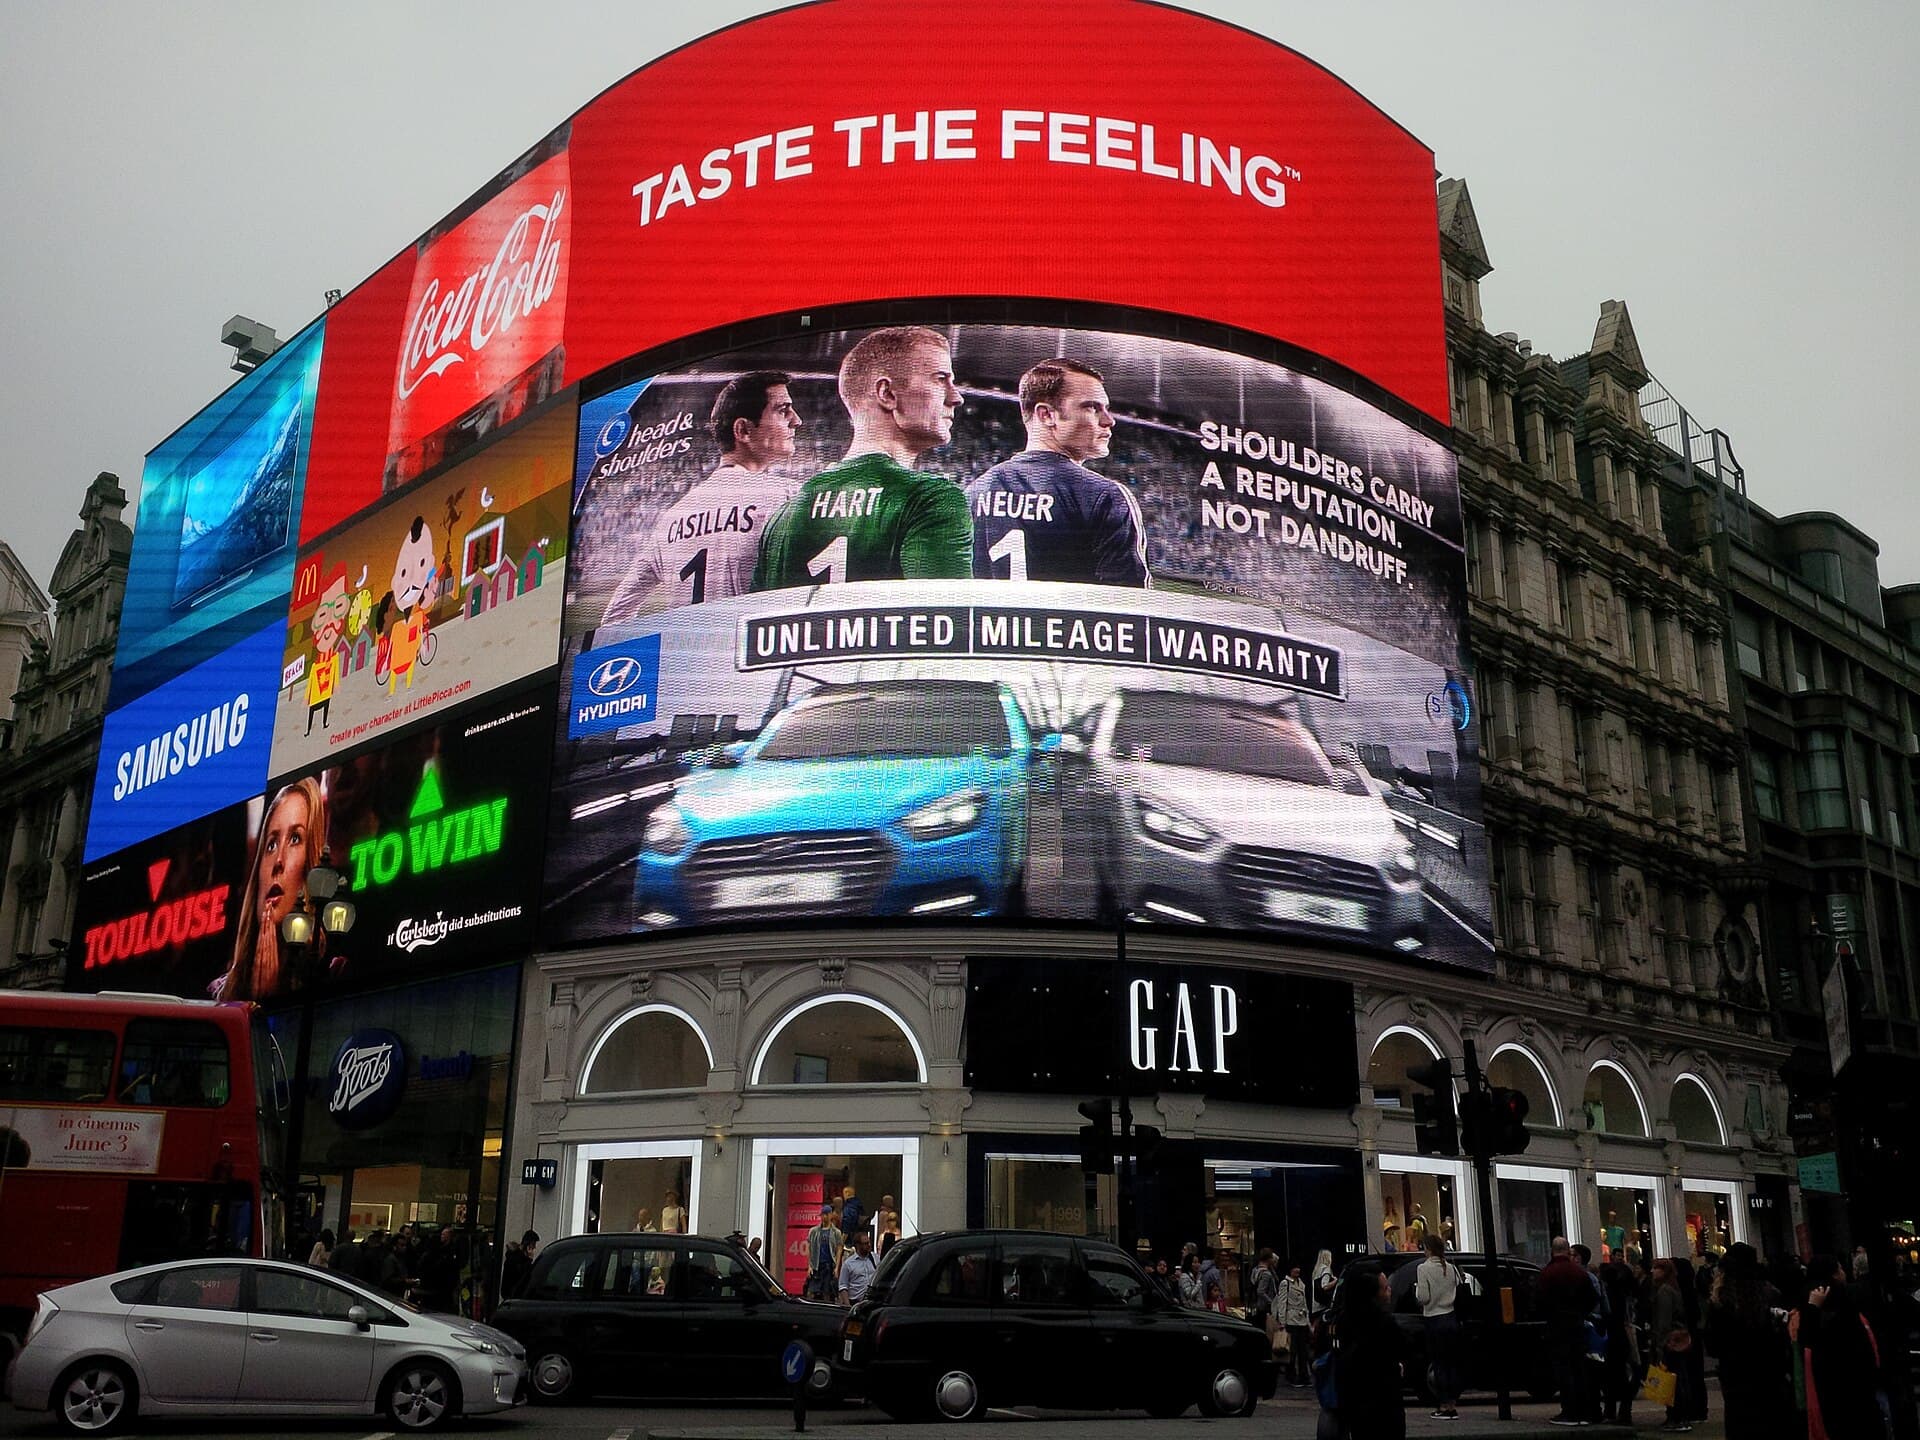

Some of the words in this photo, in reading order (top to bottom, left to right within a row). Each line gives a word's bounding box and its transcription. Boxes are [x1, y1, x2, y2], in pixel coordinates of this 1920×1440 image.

[632, 125, 814, 227] TASTE
[833, 108, 976, 167] THE
[1001, 109, 1286, 207] FEELING
[398, 184, 567, 400] Coca-Cola
[599, 436, 693, 479] shoulders
[1199, 421, 1364, 495] SHOULDERS
[1369, 476, 1434, 528] CARRY
[667, 504, 757, 543] CASILLAS
[811, 487, 884, 520] HART
[976, 491, 1054, 522] NEUER
[1200, 461, 1225, 490] A
[1236, 466, 1402, 548] REPUTATION.
[807, 537, 848, 583] 1
[988, 529, 1027, 581] 1
[1201, 499, 1270, 538] NOT
[1281, 515, 1414, 589] DANDRUFF.
[679, 548, 708, 604] 1
[284, 661, 303, 683] BEACH
[756, 615, 954, 657] UNLIMITED
[981, 615, 1135, 654] MILEAGE
[1158, 627, 1331, 684] WARRANTY
[329, 726, 352, 745] Create
[353, 722, 369, 739] your
[369, 708, 403, 730] character
[403, 703, 412, 716] at
[413, 680, 471, 711] LittlePicca.com
[464, 711, 515, 737] drinkaware.co.uk
[578, 694, 647, 724] HYUNDAI
[113, 693, 249, 801] SAMSUNG
[350, 832, 403, 892] TO
[409, 797, 508, 874] WIN
[83, 885, 231, 969] TOULOUSE
[387, 932, 395, 946] If
[396, 914, 449, 952] Carlsberg
[448, 916, 464, 931] did
[464, 906, 522, 928] substitutions
[1129, 979, 1238, 1074] GAP
[329, 1042, 393, 1112] Boots
[58, 1114, 73, 1129] in
[77, 1115, 140, 1131] cinemas
[63, 1133, 112, 1151] June
[117, 1134, 129, 1153] 3
[790, 1183, 822, 1193] TODAY
